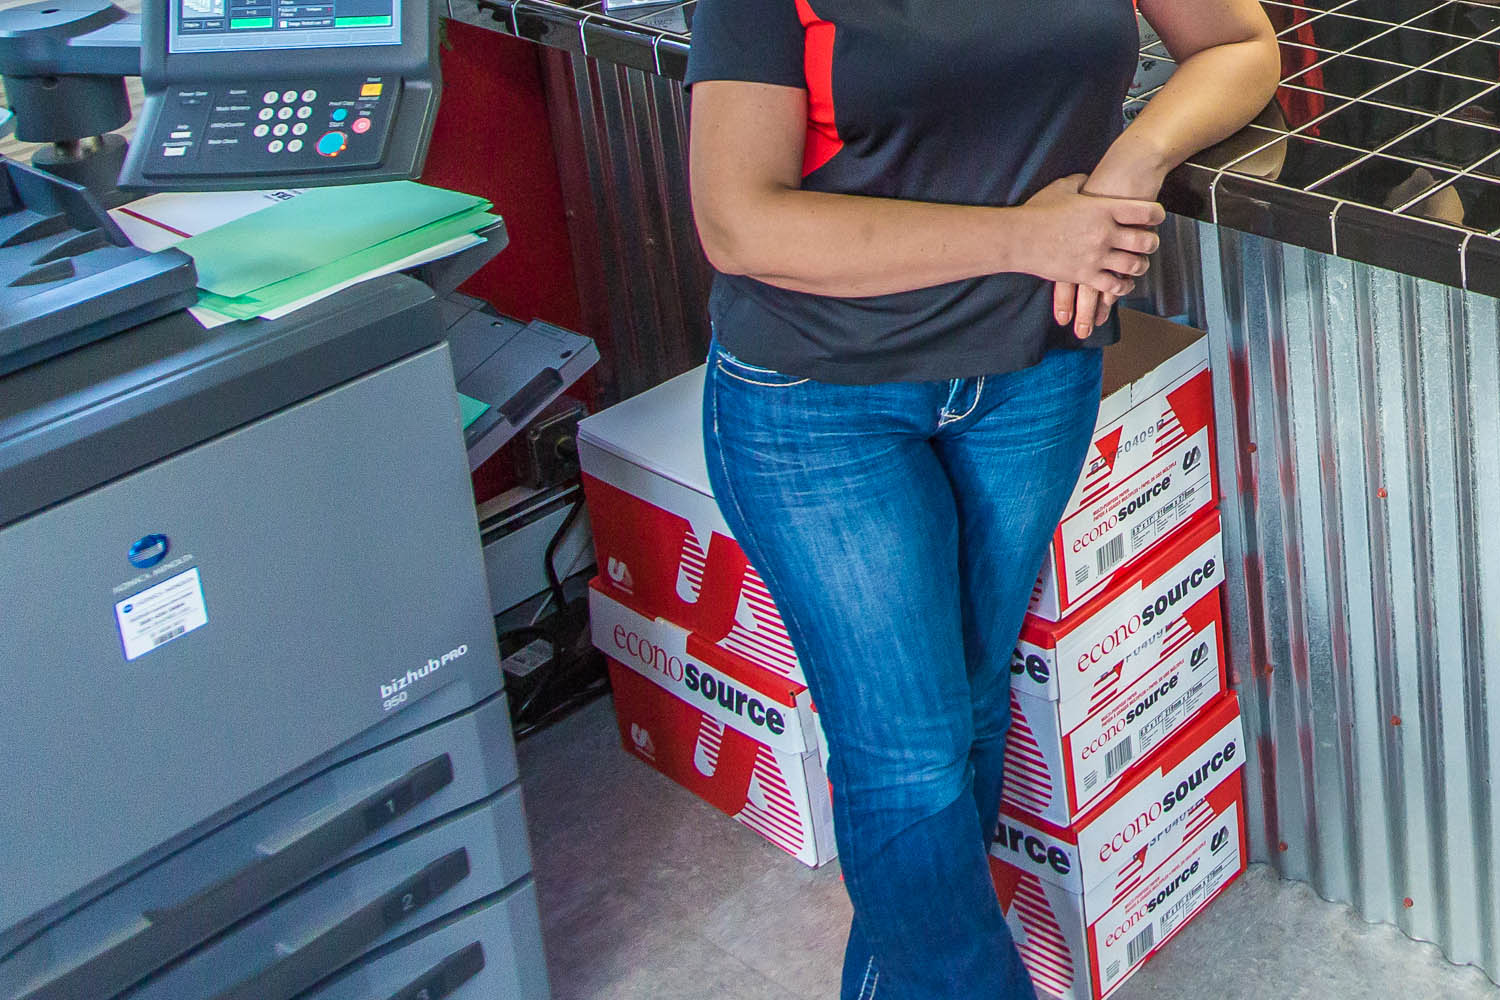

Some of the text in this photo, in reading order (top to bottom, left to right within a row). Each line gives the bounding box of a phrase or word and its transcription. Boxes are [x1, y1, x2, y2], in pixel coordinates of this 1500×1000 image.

[1072, 476, 1172, 553] econosource
[1077, 557, 1216, 672] econosource
[380, 644, 468, 698] bizhub PRO
[383, 690, 407, 710] 950
[614, 624, 785, 735] econosource
[1082, 674, 1179, 760] econosource
[1099, 741, 1236, 862] econosource
[402, 894, 414, 910] 2
[1105, 860, 1199, 948] econosource
